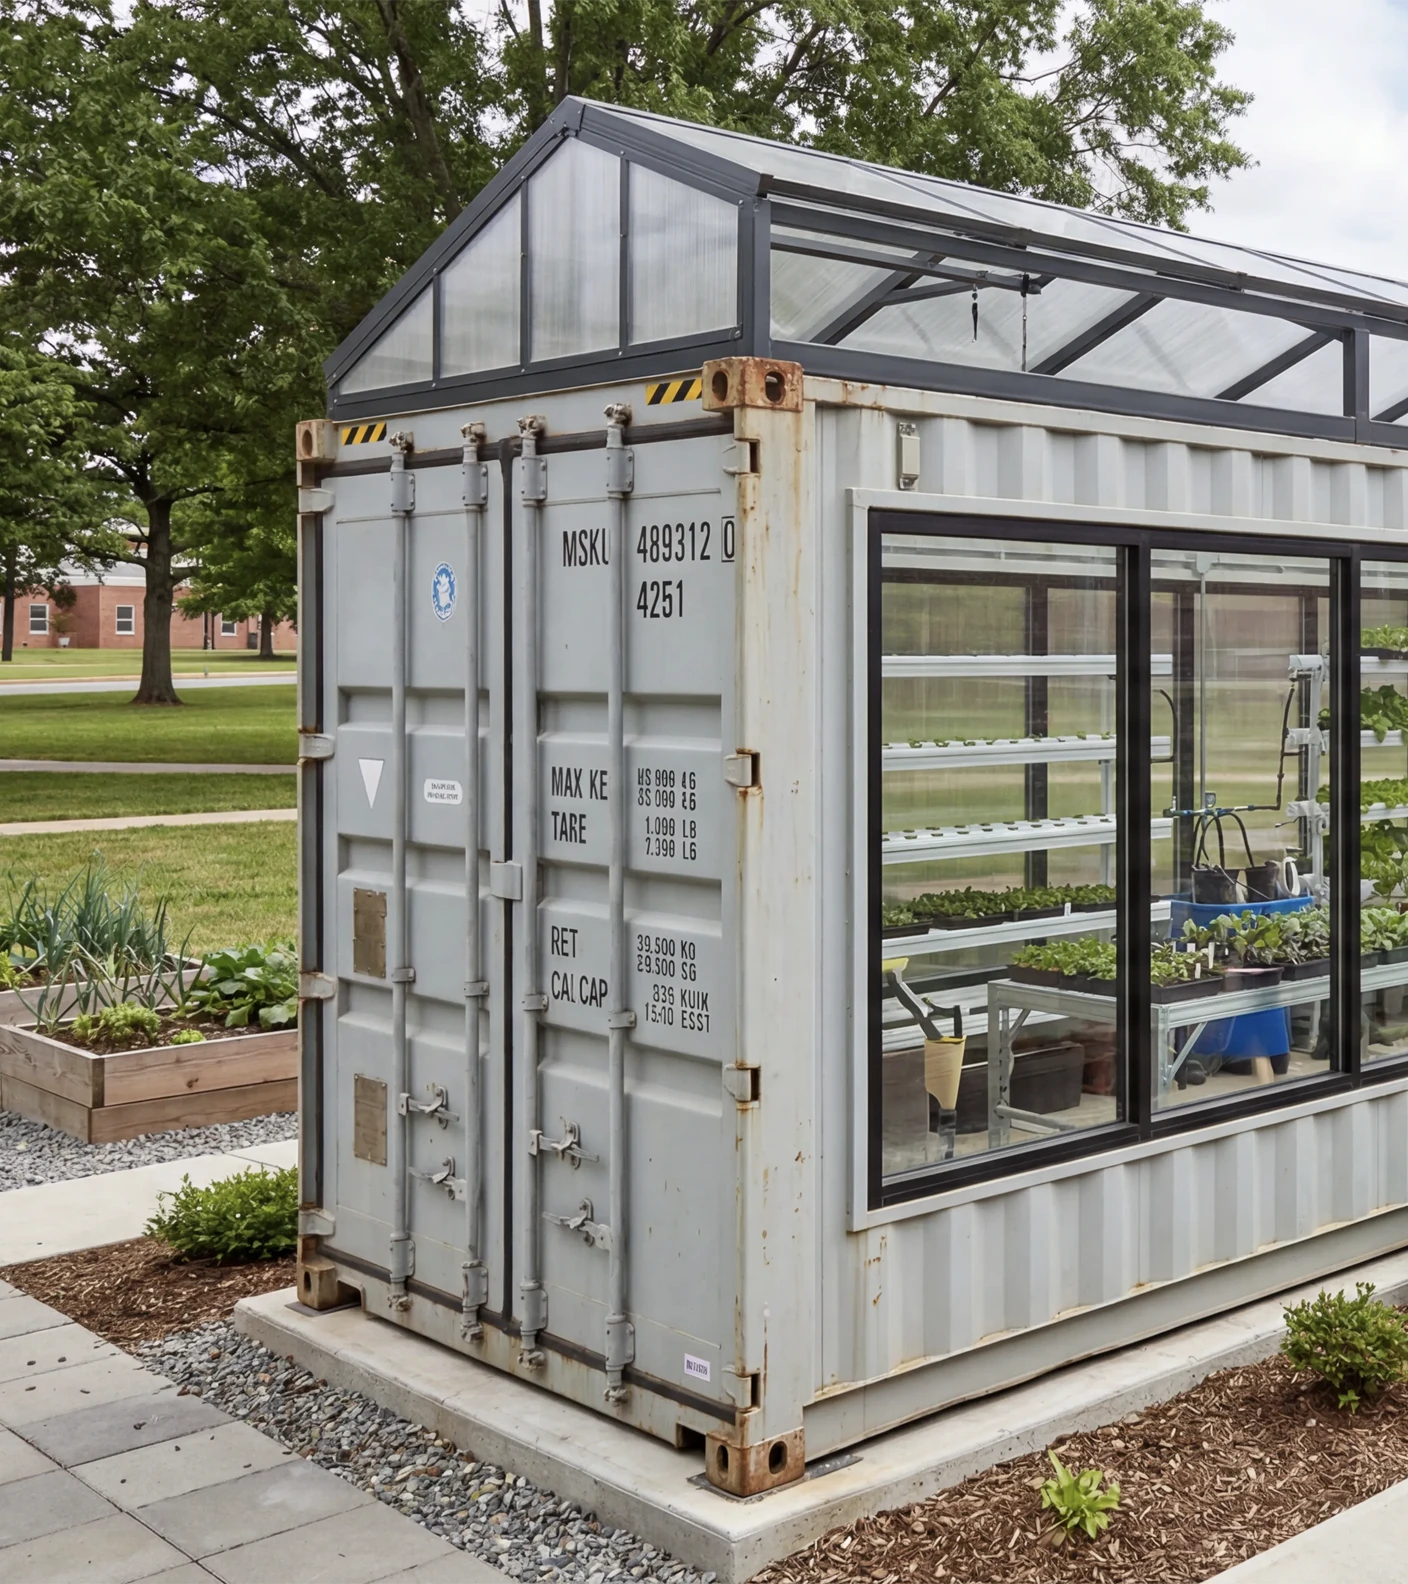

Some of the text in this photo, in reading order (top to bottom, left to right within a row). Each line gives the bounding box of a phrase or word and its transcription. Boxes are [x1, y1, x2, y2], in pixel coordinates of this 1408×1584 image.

[637, 521, 711, 563] 489312
[637, 580, 683, 619] 4251
[551, 766, 583, 799] MAX
[551, 811, 587, 844] TARE
[551, 926, 578, 958] RET
[579, 975, 608, 1008] CAP
